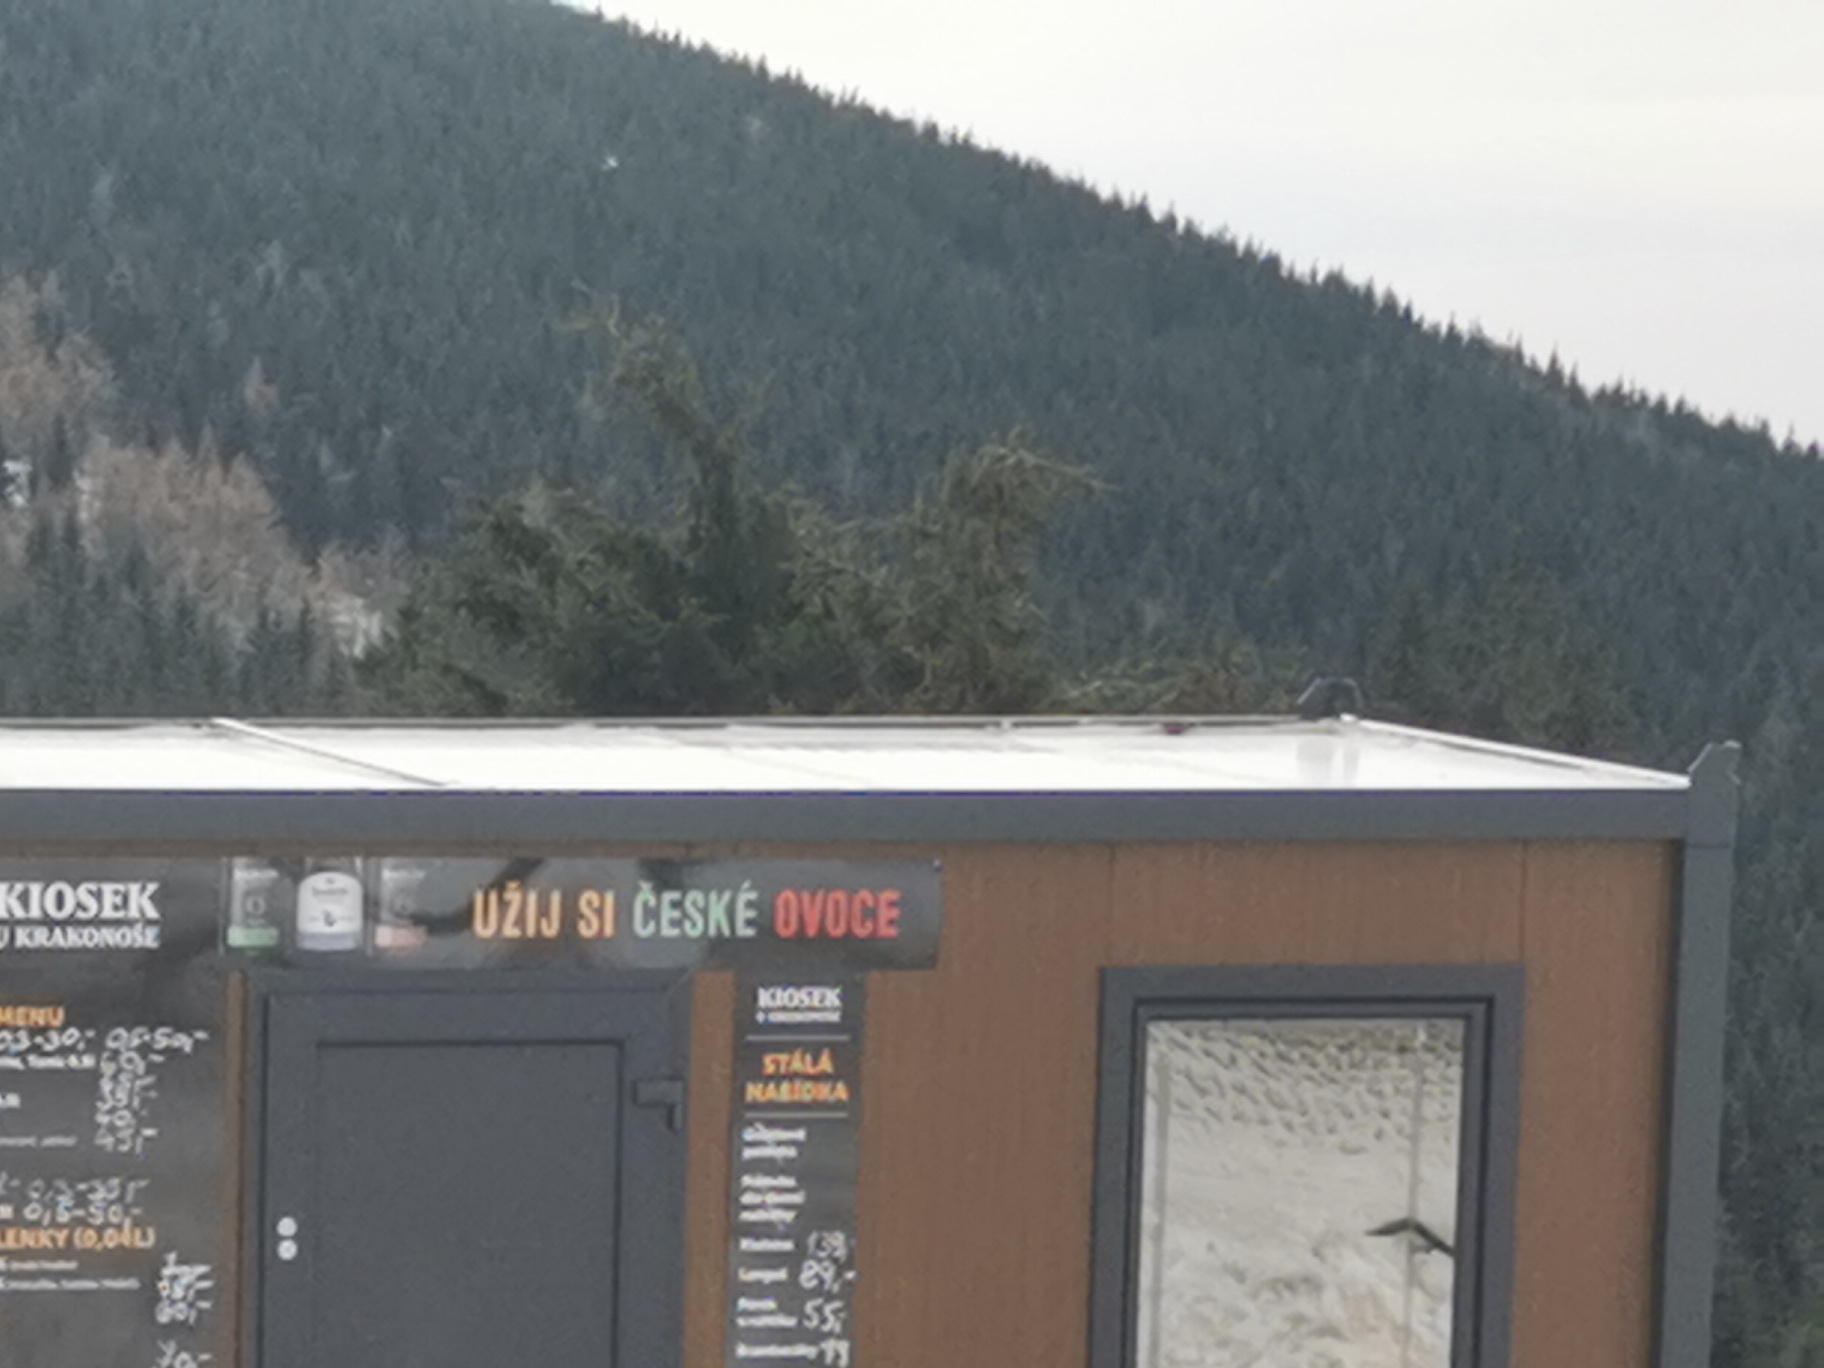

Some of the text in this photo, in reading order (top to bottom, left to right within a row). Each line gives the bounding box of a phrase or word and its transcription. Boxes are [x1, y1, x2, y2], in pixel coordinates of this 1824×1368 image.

[473, 880, 901, 937] UŽIJ SI ČESKÉ OVOCE
[15, 923, 160, 949] KRAKONOŠE
[757, 986, 842, 1008] KIOSEK
